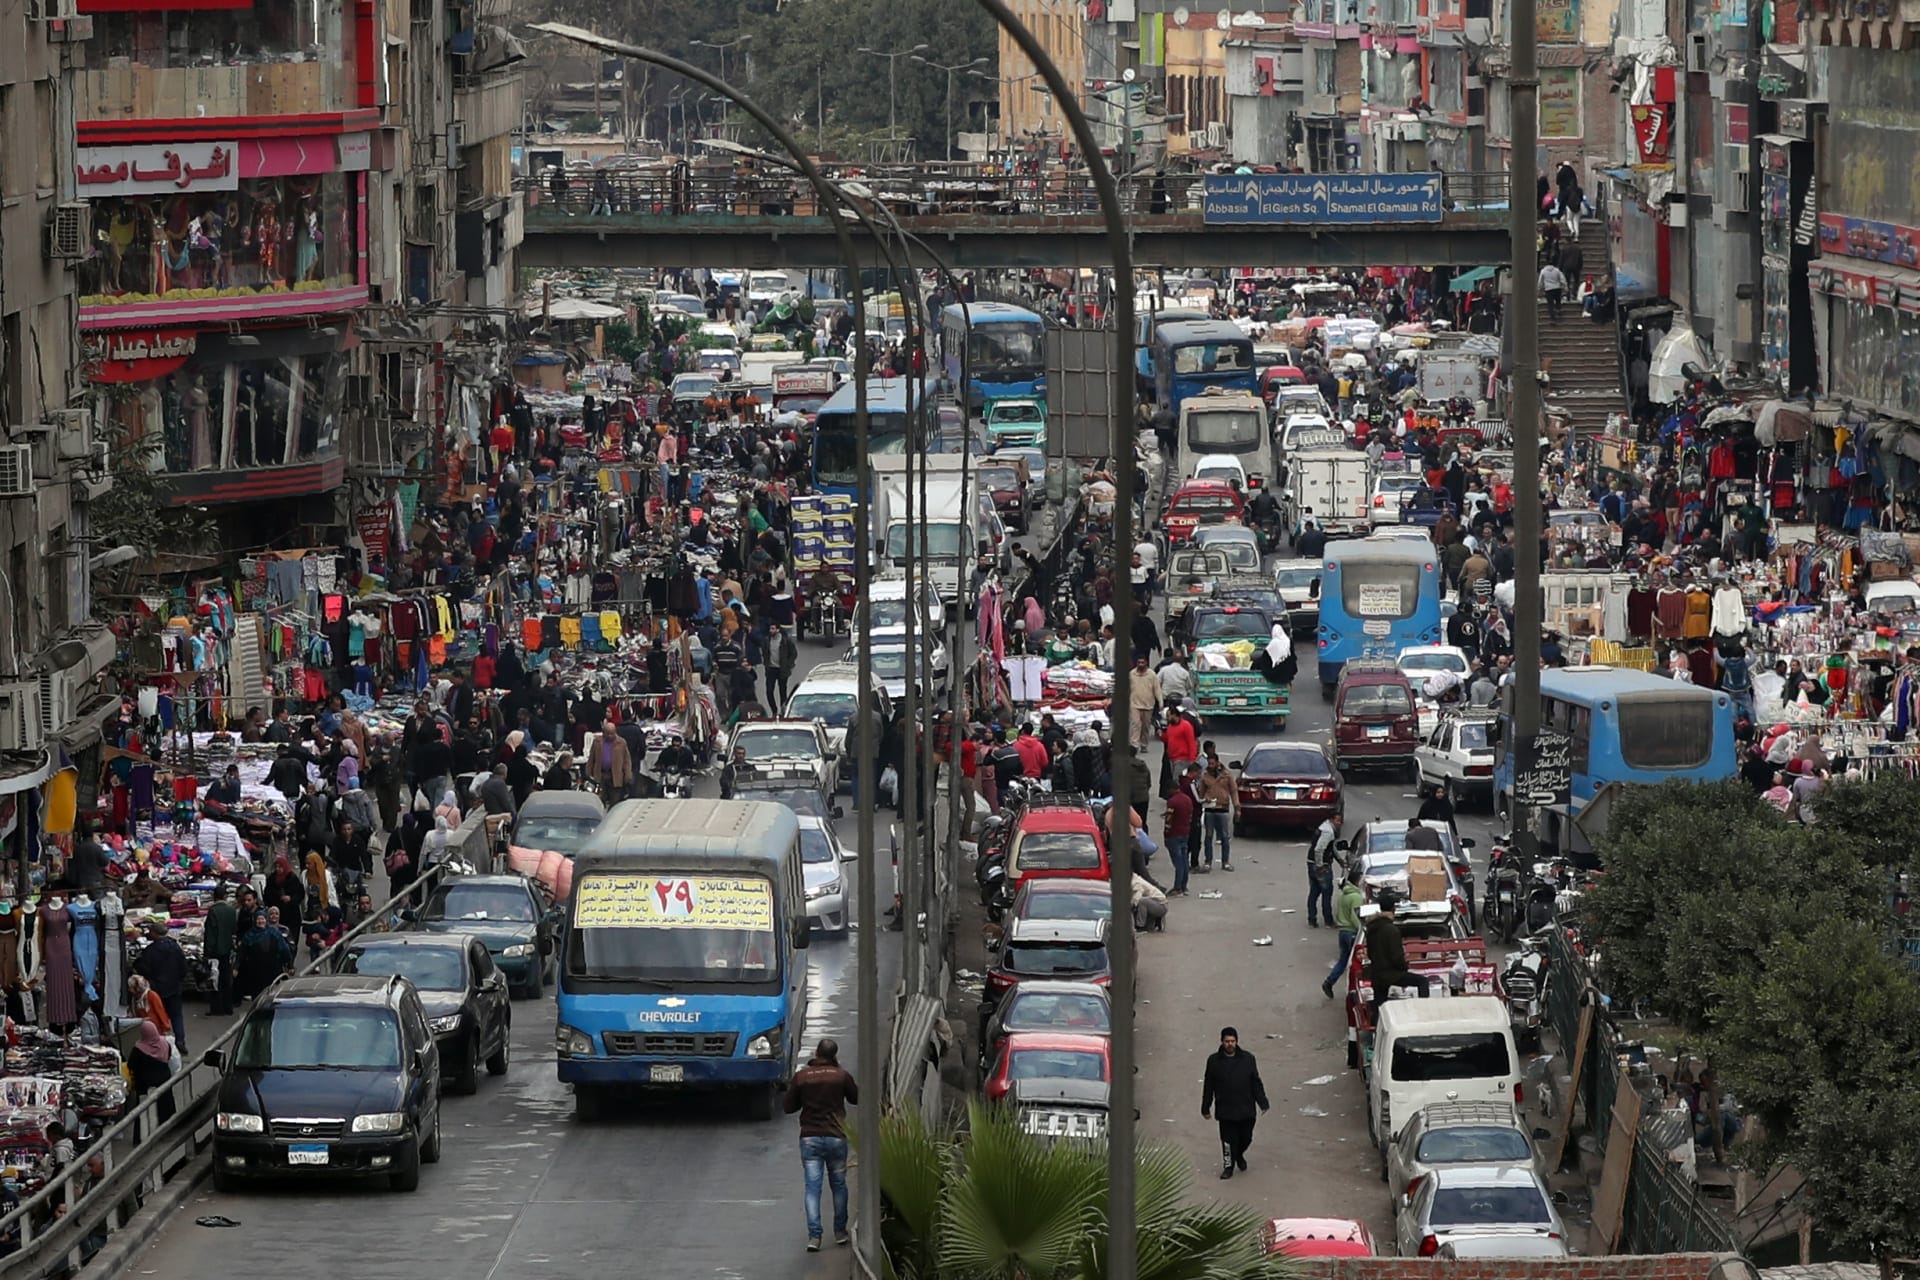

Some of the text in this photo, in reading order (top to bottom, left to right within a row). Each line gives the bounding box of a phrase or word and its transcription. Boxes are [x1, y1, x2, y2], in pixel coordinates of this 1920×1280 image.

[1208, 180, 1244, 195] العباسية
[1262, 181, 1312, 196] ميدان الجيش
[1332, 180, 1419, 195] محور شمال الجمالية
[1207, 202, 1249, 214] Abbasia
[1330, 202, 1366, 213] Shamal
[1378, 202, 1418, 213] Gamalia
[655, 880, 695, 915] ٢٩
[639, 1011, 701, 1023] CHEVROLET
